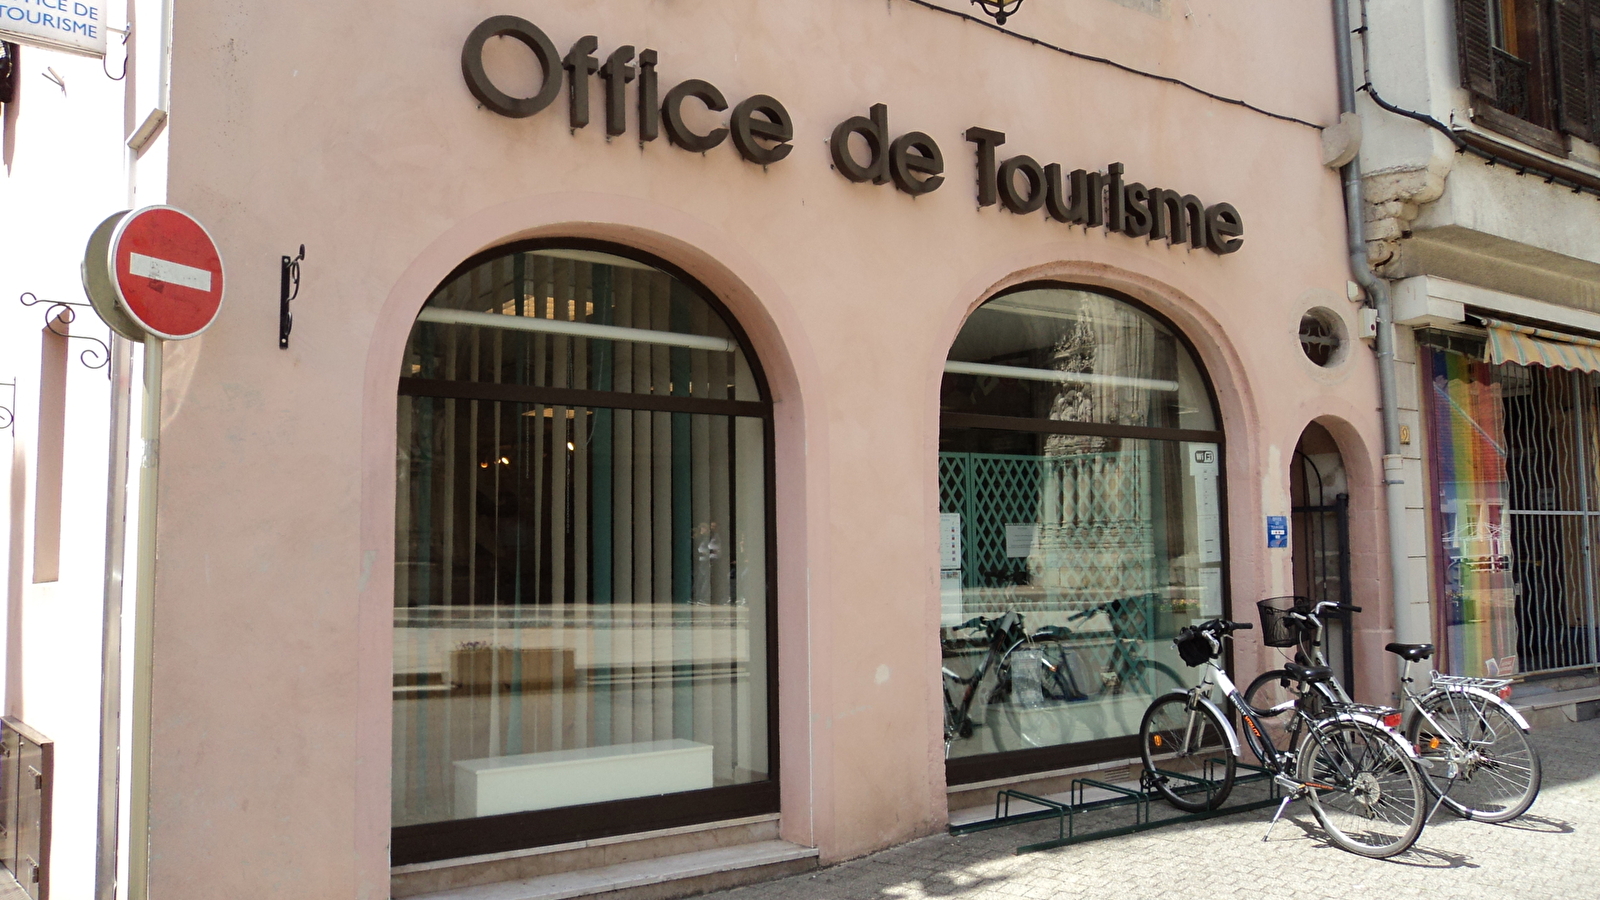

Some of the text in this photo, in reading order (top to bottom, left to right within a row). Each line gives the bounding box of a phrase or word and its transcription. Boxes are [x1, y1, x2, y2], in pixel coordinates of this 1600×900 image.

[74, 2, 98, 21] DE
[461, 15, 1244, 256] Office de Tourisme
